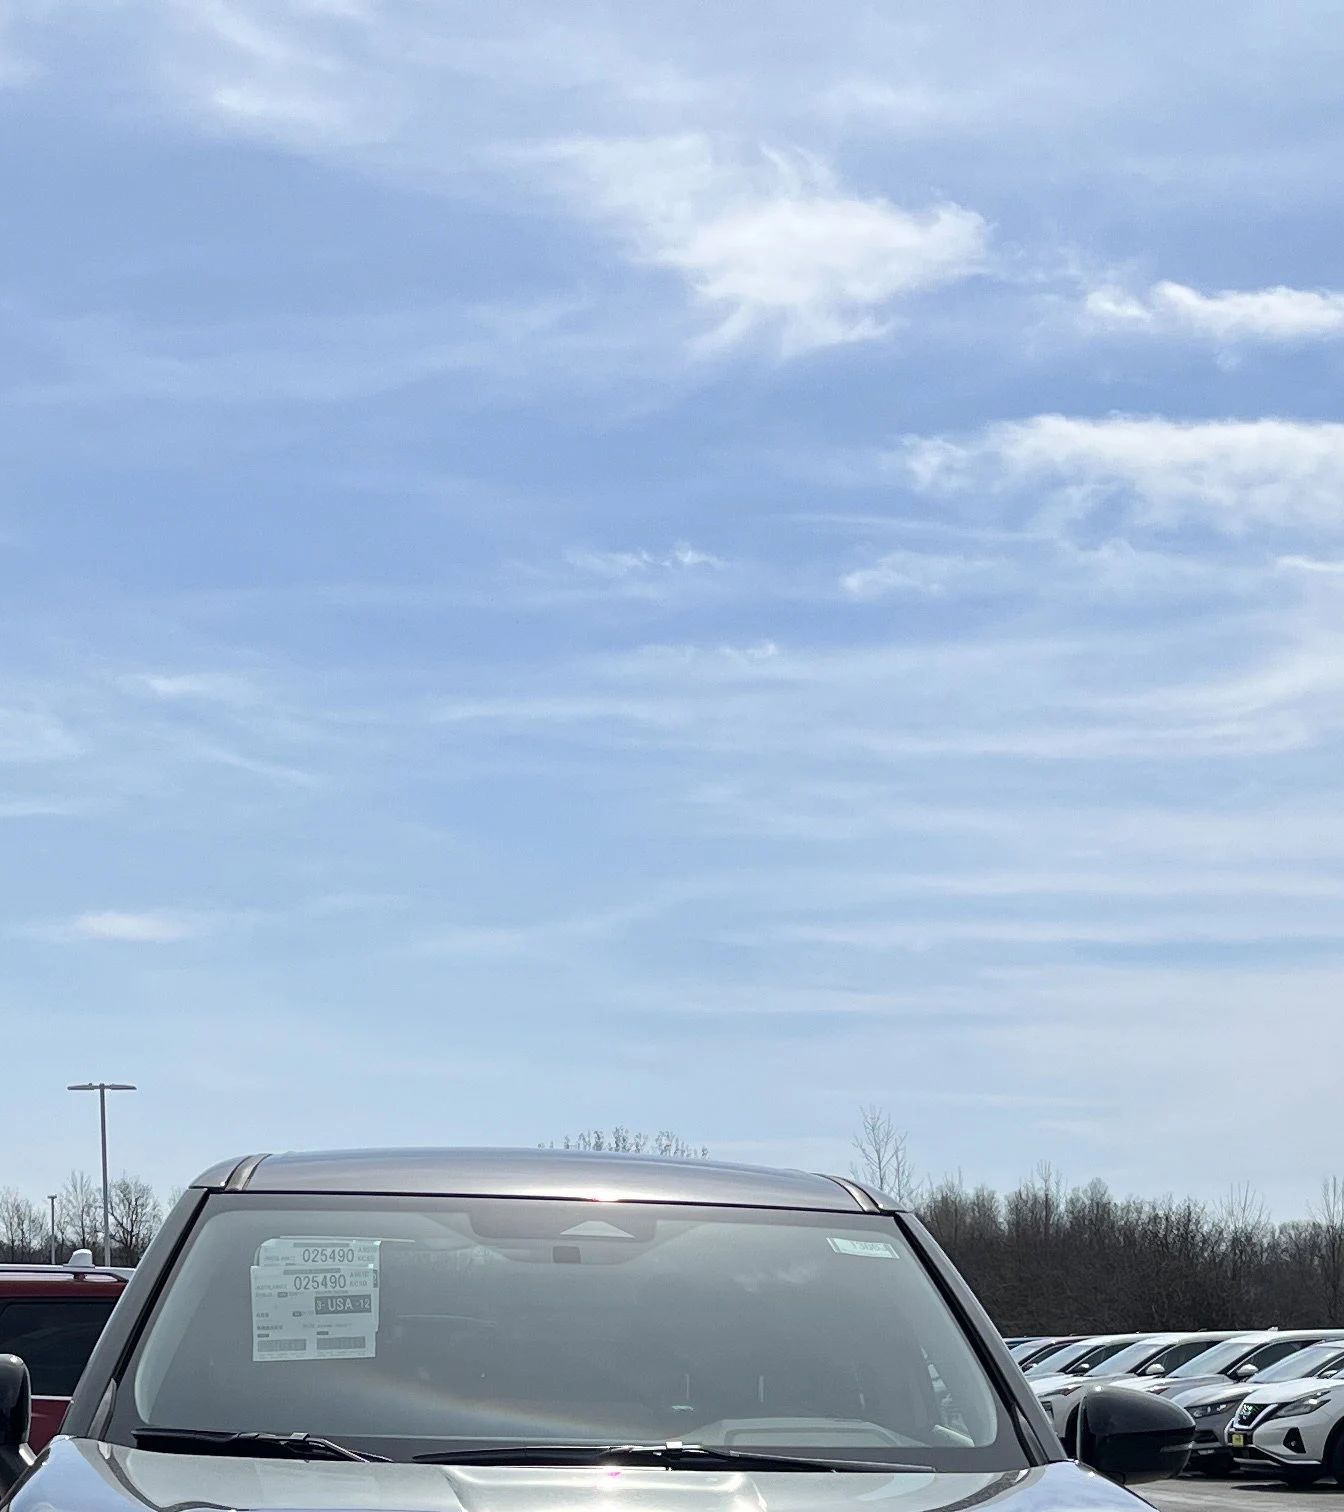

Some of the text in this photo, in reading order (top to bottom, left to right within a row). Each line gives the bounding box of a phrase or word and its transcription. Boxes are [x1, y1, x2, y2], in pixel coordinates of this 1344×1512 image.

[302, 1248, 355, 1263] 025490
[293, 1274, 347, 1291] 025490
[327, 1298, 353, 1311] USA
